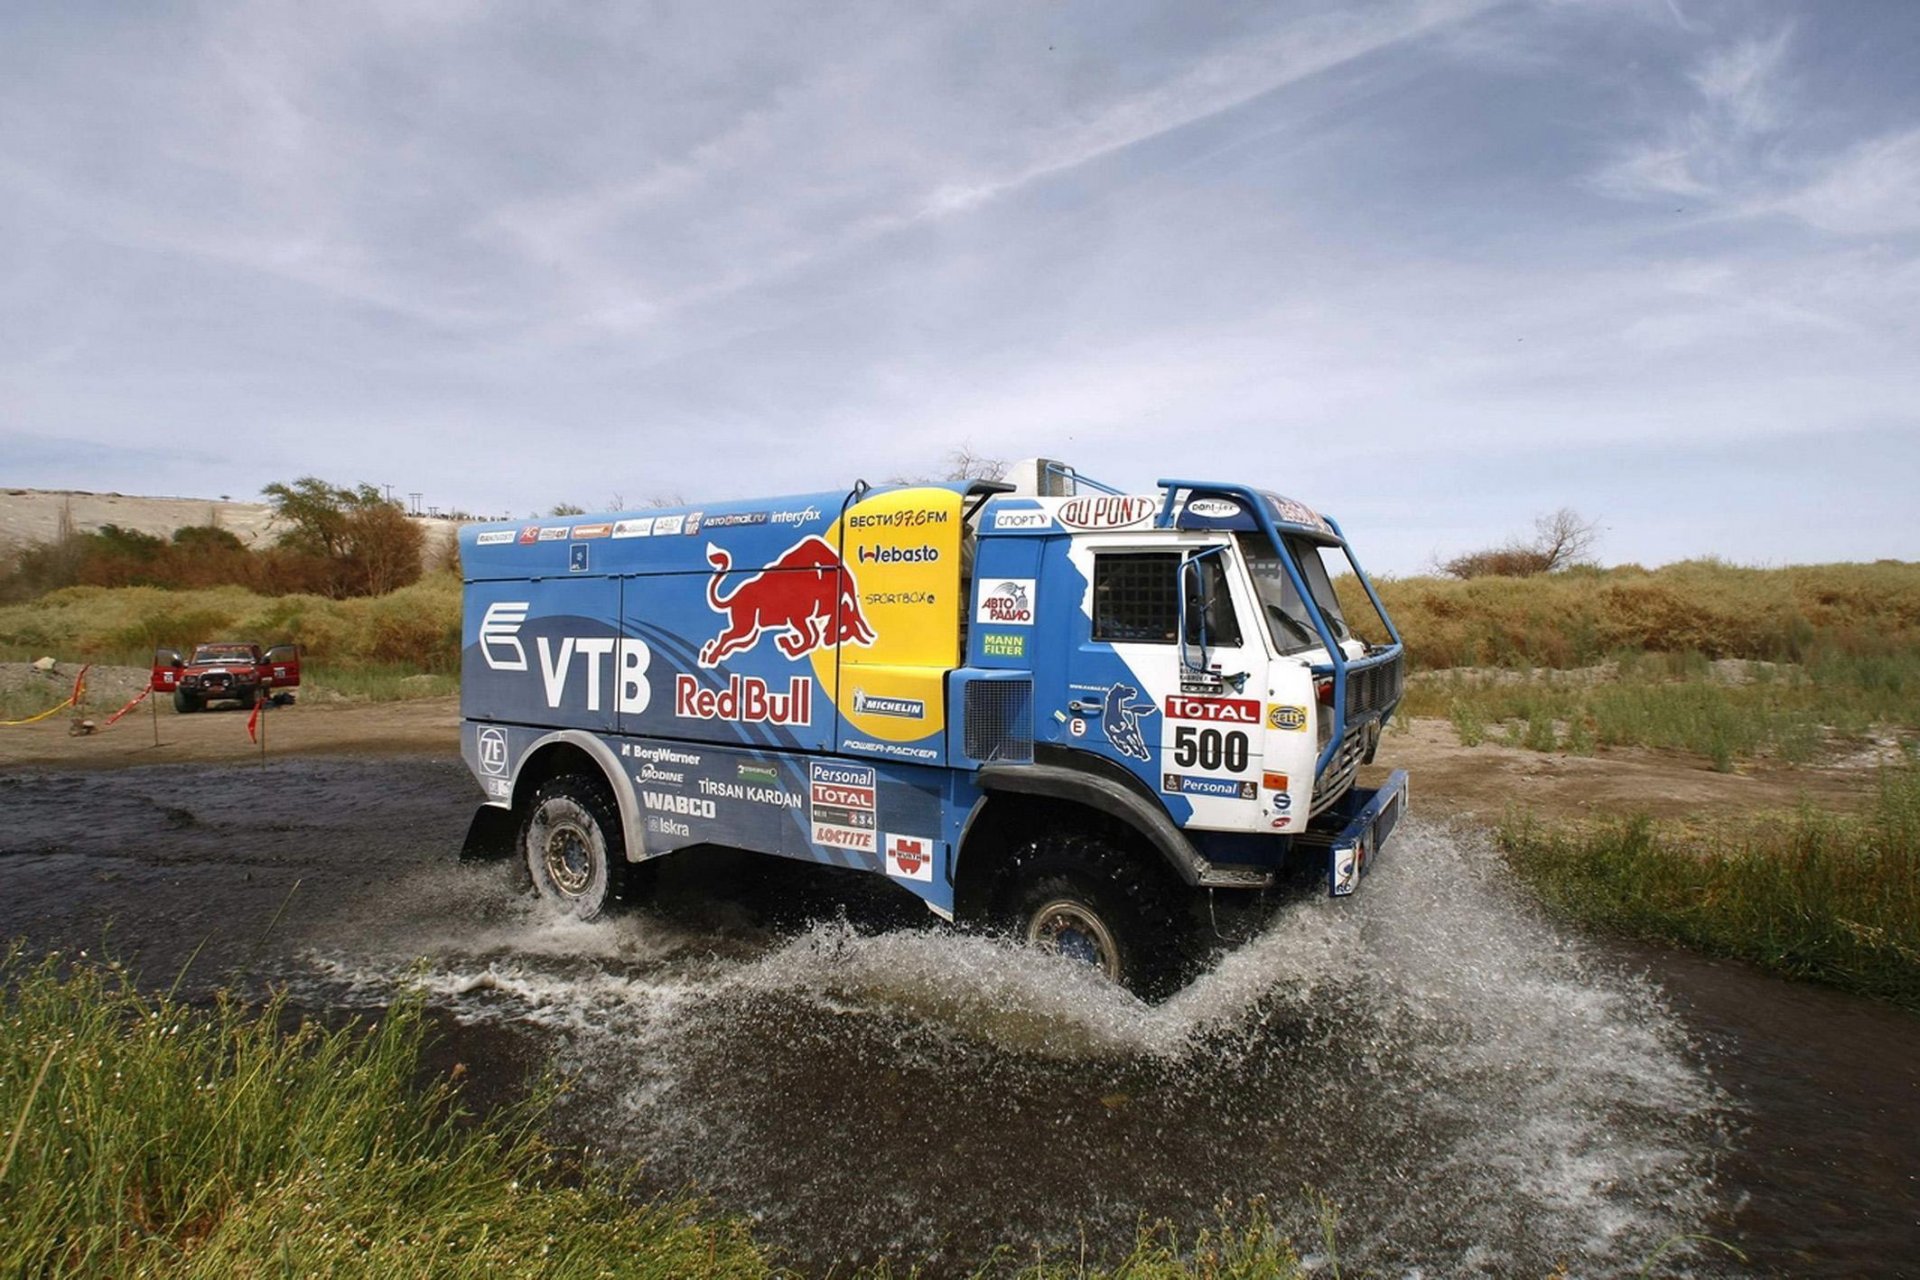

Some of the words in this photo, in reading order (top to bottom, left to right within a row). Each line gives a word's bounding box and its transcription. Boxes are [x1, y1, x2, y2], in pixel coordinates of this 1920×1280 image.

[997, 514, 1038, 527] СПОРТ
[858, 544, 939, 564] Webasto
[982, 597, 1015, 610] АВТО
[989, 608, 1031, 622] РАДИО
[984, 634, 1023, 646] MANN
[984, 645, 1023, 656] FILTER
[536, 636, 651, 714] VTB
[675, 672, 740, 721] Red
[742, 675, 813, 727] Bull
[866, 700, 922, 714] MICHELIN
[1168, 697, 1258, 722] TOTAL
[633, 745, 701, 766] BorgWarner
[1174, 726, 1249, 773] 500
[641, 768, 684, 784] MODINE
[813, 766, 872, 786] Personal
[813, 785, 872, 807] TOTAL
[1182, 778, 1238, 795] Personal
[643, 790, 716, 819] WABCO
[746, 786, 802, 809] KARDAN
[659, 817, 690, 837] Iskra
[816, 827, 872, 848] LOCTITE
